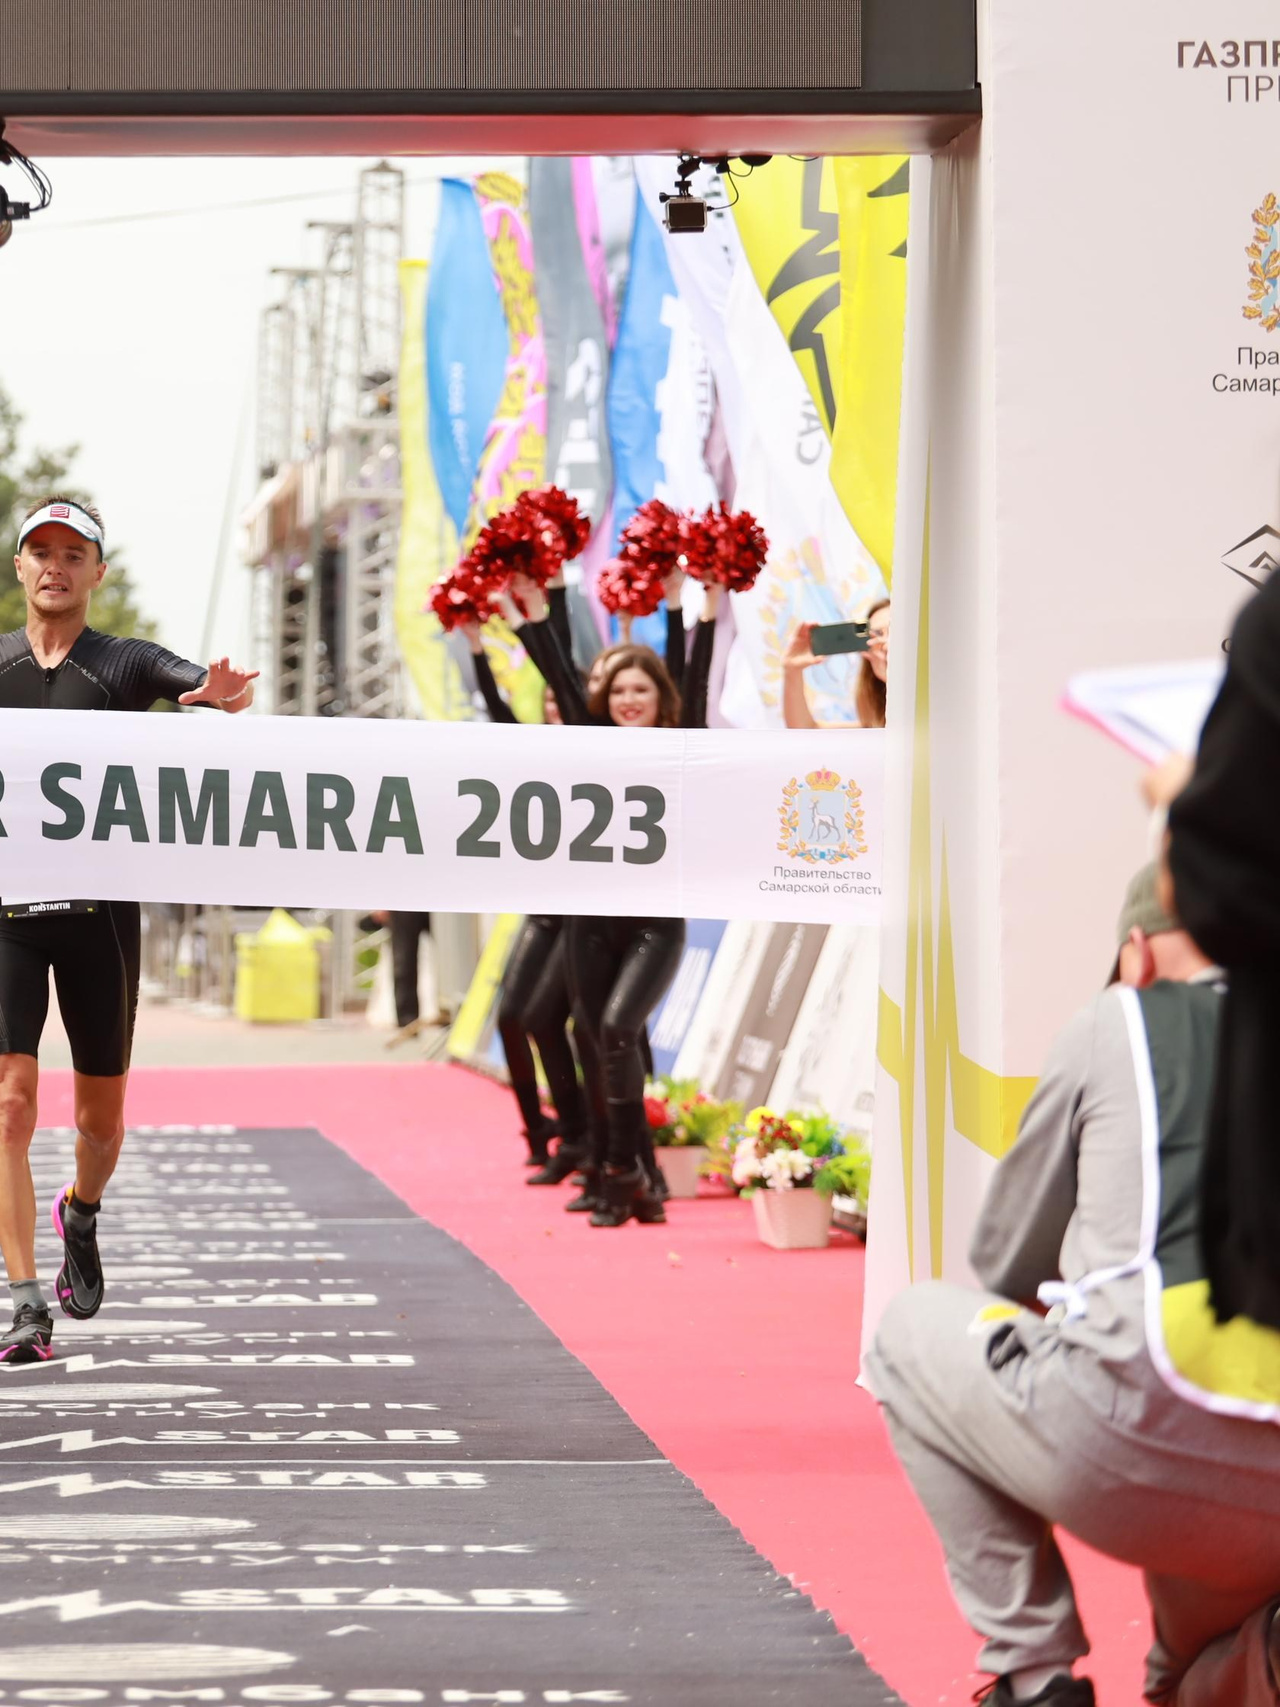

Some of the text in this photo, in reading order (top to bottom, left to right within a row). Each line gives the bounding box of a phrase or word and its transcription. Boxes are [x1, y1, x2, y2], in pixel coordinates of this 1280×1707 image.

[1227, 74, 1280, 103] ПР
[40, 761, 425, 856] SAMARA
[455, 778, 667, 865] 2023
[773, 866, 872, 881] Правительство
[758, 880, 830, 894] Самарской
[28, 902, 71, 913] KONSTANTIN
[154, 1429, 461, 1441] STAR
[156, 1470, 489, 1485] STAR
[177, 1587, 571, 1606] STAR
